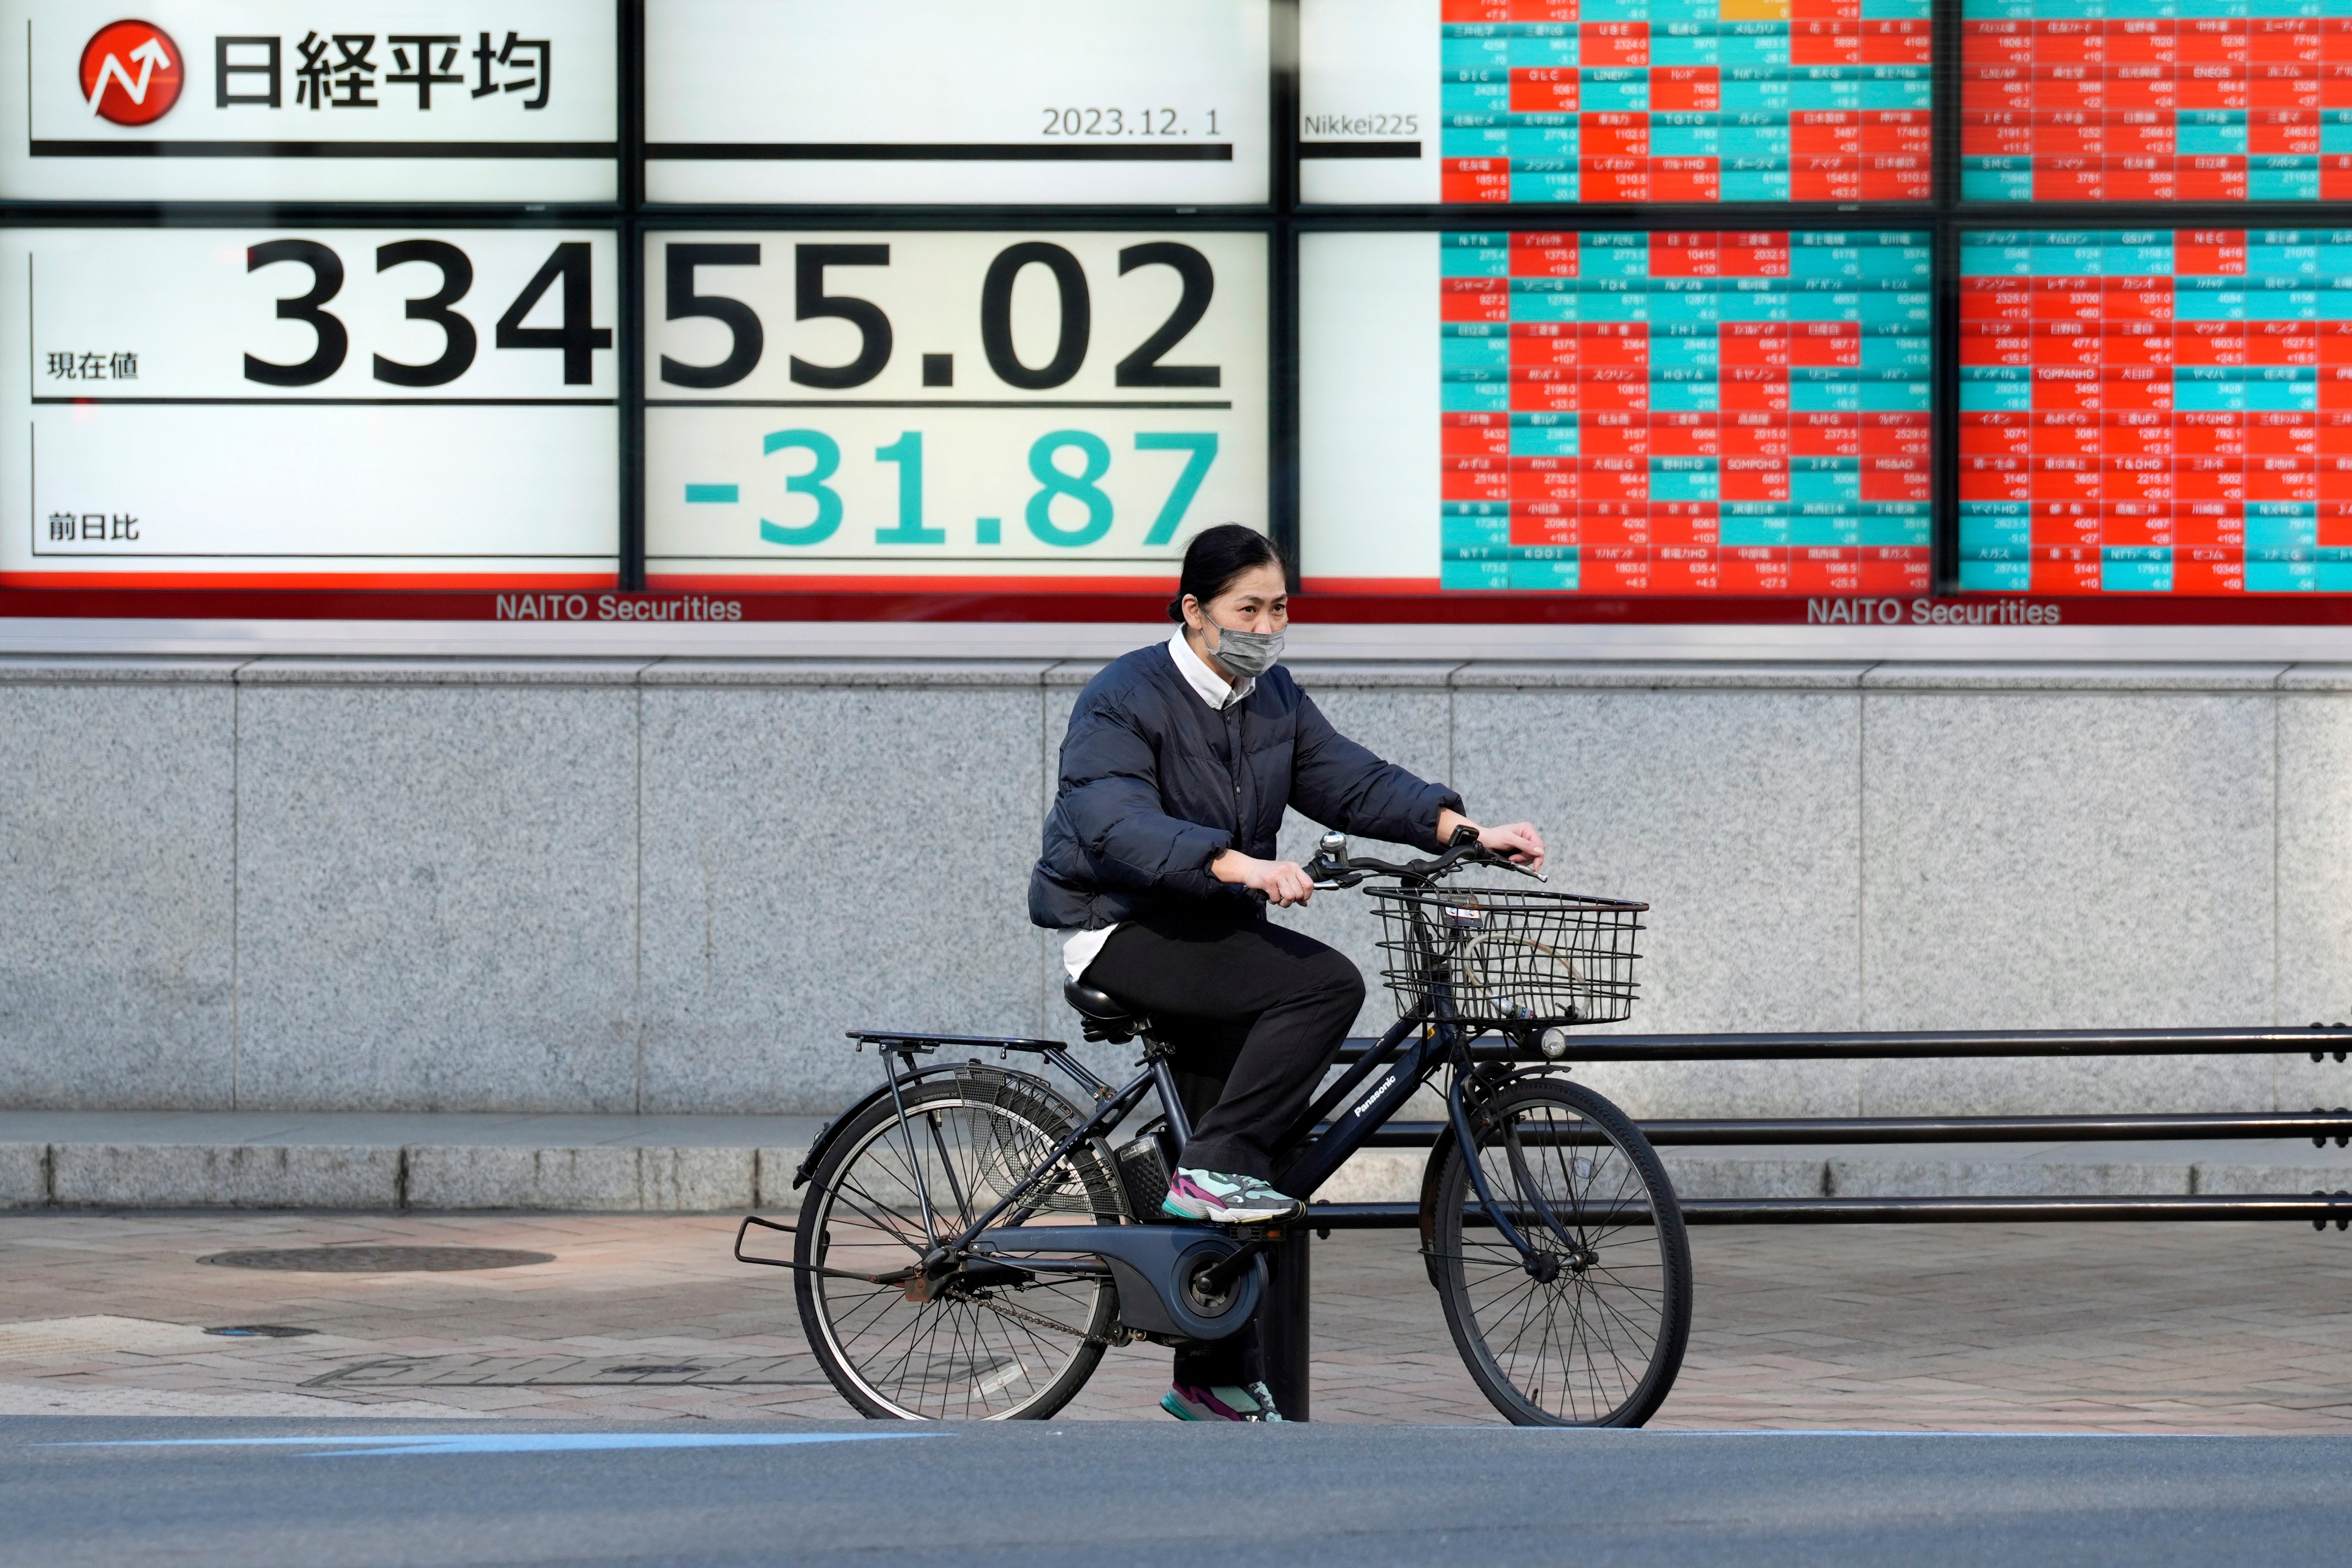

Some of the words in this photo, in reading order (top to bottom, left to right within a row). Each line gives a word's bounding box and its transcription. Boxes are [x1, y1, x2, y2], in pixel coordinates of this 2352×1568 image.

[215, 30, 552, 110] 日経平均
[1305, 114, 1418, 135] Nikkei225
[47, 351, 138, 380] 現在値
[685, 429, 1220, 548] -31.87
[49, 512, 139, 541] 前日比
[496, 594, 588, 620] NAITO
[598, 594, 742, 620] Securities
[1807, 598, 1900, 623] NAITO
[1911, 598, 2059, 624] Securities
[921, 1093, 950, 1101] BRIDGESTONE
[1354, 1075, 1396, 1118] Panasonic
